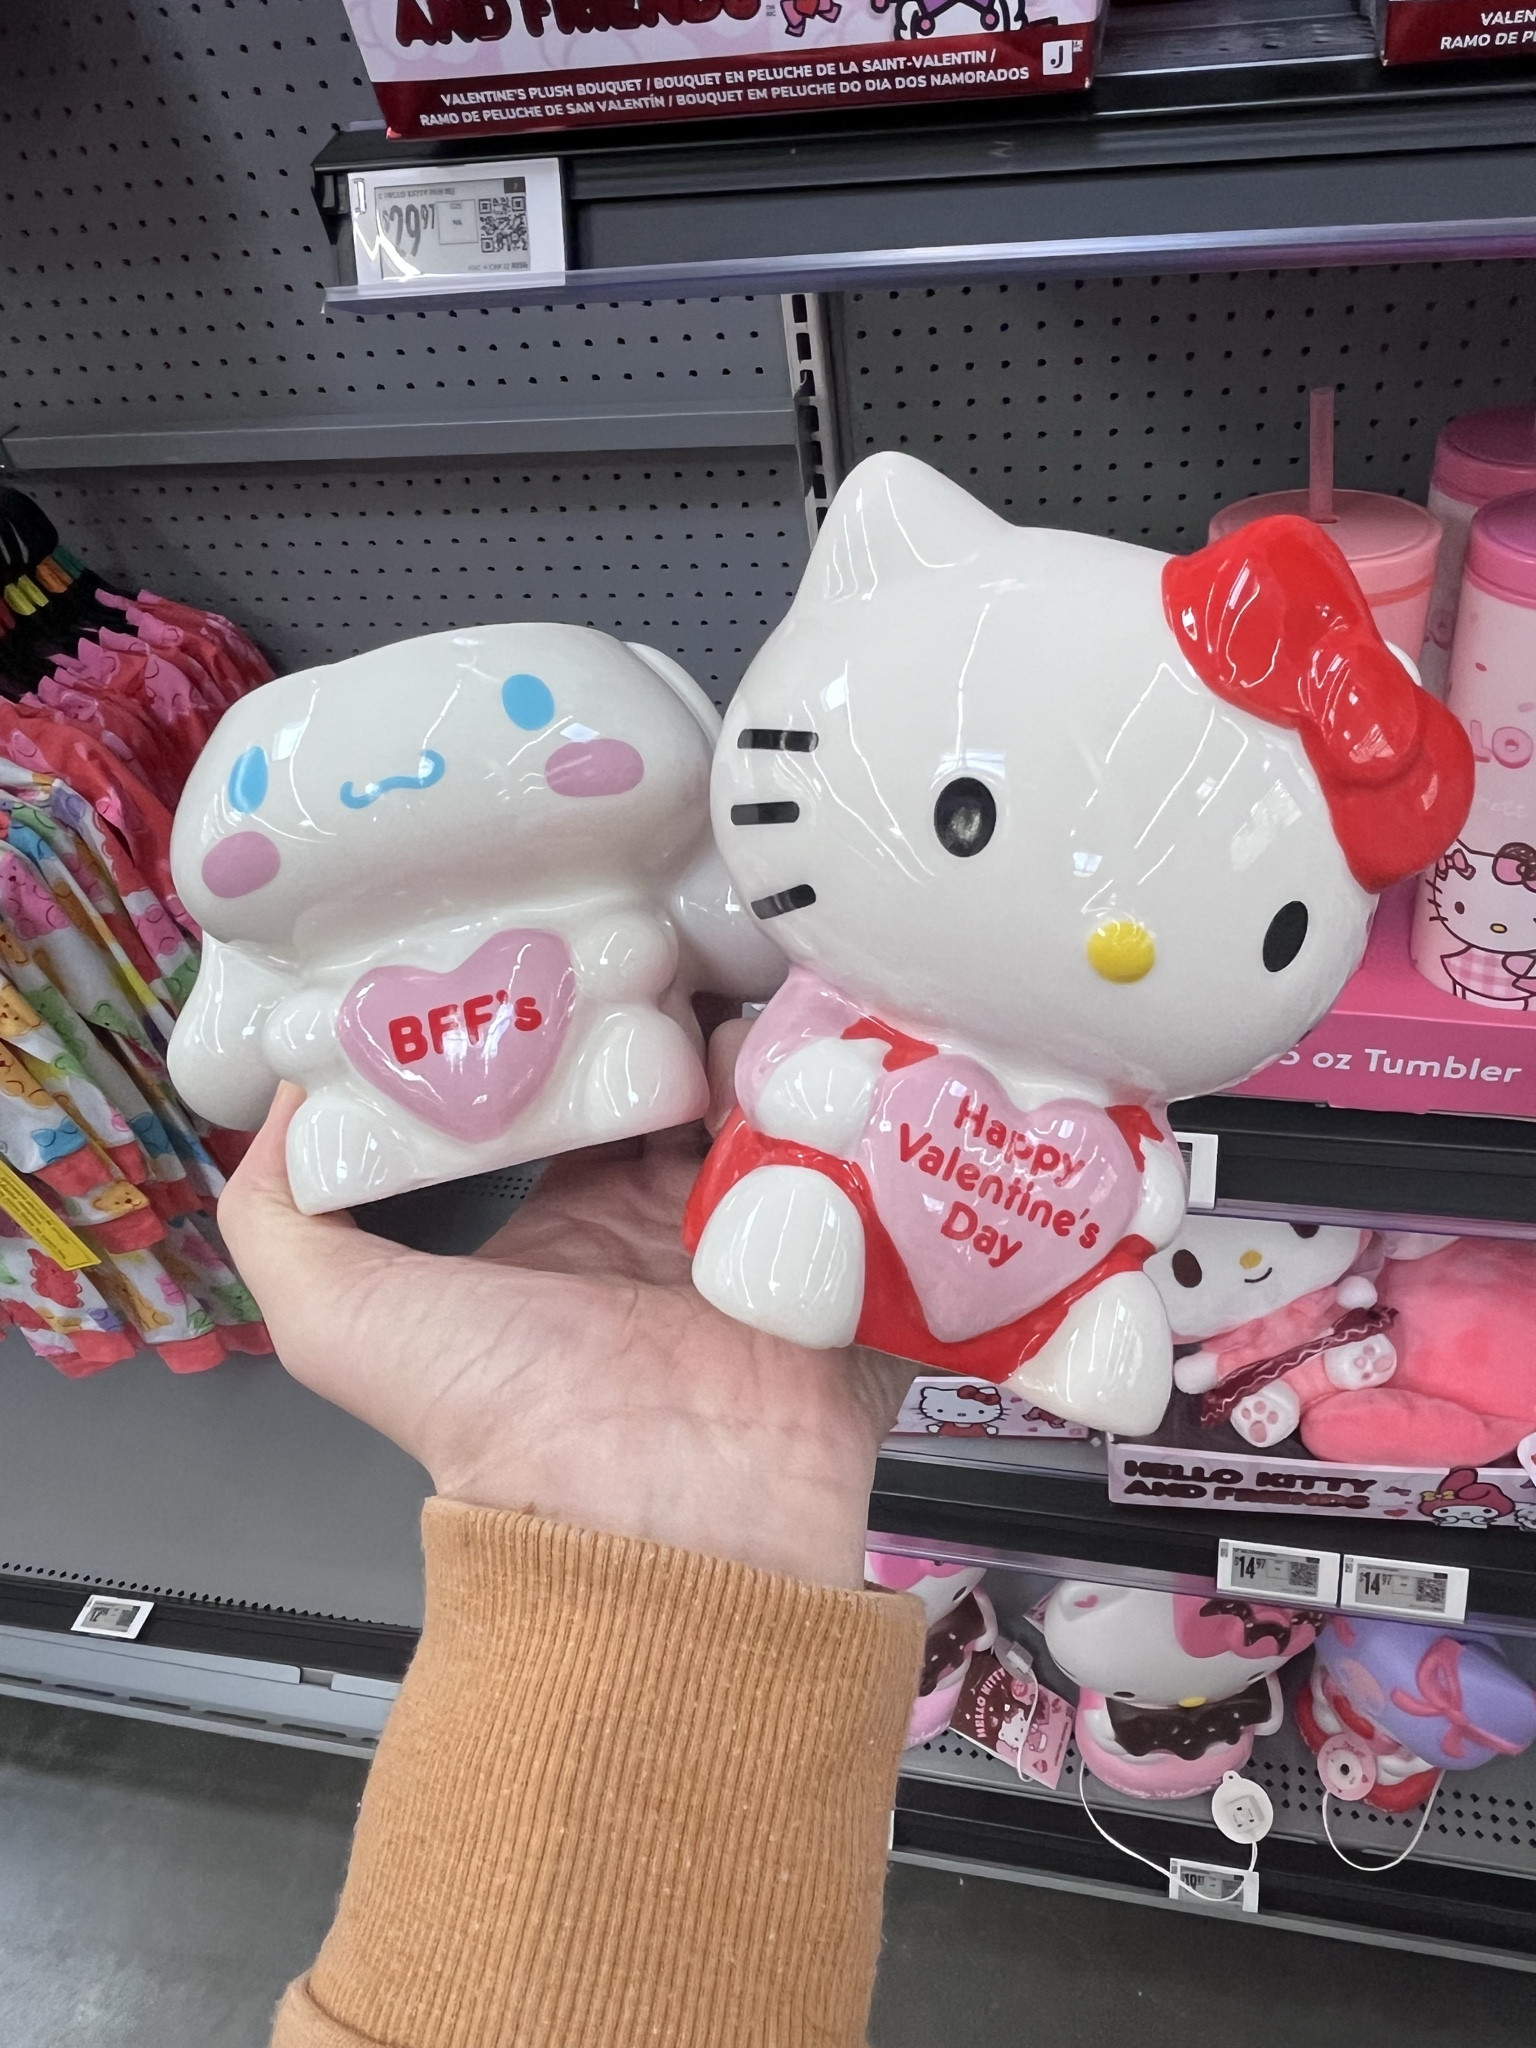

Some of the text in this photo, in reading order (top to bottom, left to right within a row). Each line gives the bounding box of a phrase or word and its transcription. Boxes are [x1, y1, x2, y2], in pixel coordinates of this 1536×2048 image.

[1440, 34, 1491, 50] RAMO
[1495, 32, 1519, 46] DE
[419, 112, 460, 126] RAMO
[461, 110, 481, 123] DE
[482, 104, 543, 121] PELUCHE
[545, 102, 564, 117] DE
[568, 101, 595, 115] SAN
[597, 93, 665, 112] VALENTÍN
[677, 89, 743, 106] BOUQUET
[747, 87, 768, 100] EM
[771, 82, 836, 99] PELUCHE
[839, 80, 861, 94] DO
[865, 77, 892, 92] DIA
[895, 74, 927, 89] DOS
[930, 67, 1030, 87] NAMORADOS
[440, 88, 527, 107] VALENTINE'S
[529, 84, 574, 99] PLUSH
[576, 79, 642, 96] BOUQUET
[653, 72, 722, 90] BOUQUET
[725, 71, 745, 84] EN
[747, 64, 813, 82] PELUCHE
[816, 63, 836, 76] DE
[839, 61, 859, 74] LA
[862, 50, 987, 73] SAINT-VALENTIN
[389, 989, 542, 1064] BFF's
[1313, 1052, 1353, 1070] oz
[1364, 1048, 1522, 1083] Tumbler
[954, 1095, 1085, 1187] Happy
[900, 1123, 1100, 1248] Valentine's
[940, 1201, 1023, 1268] Day
[1124, 1460, 1378, 1493] HELLO KITTY
[1124, 1480, 1207, 1499] AND
